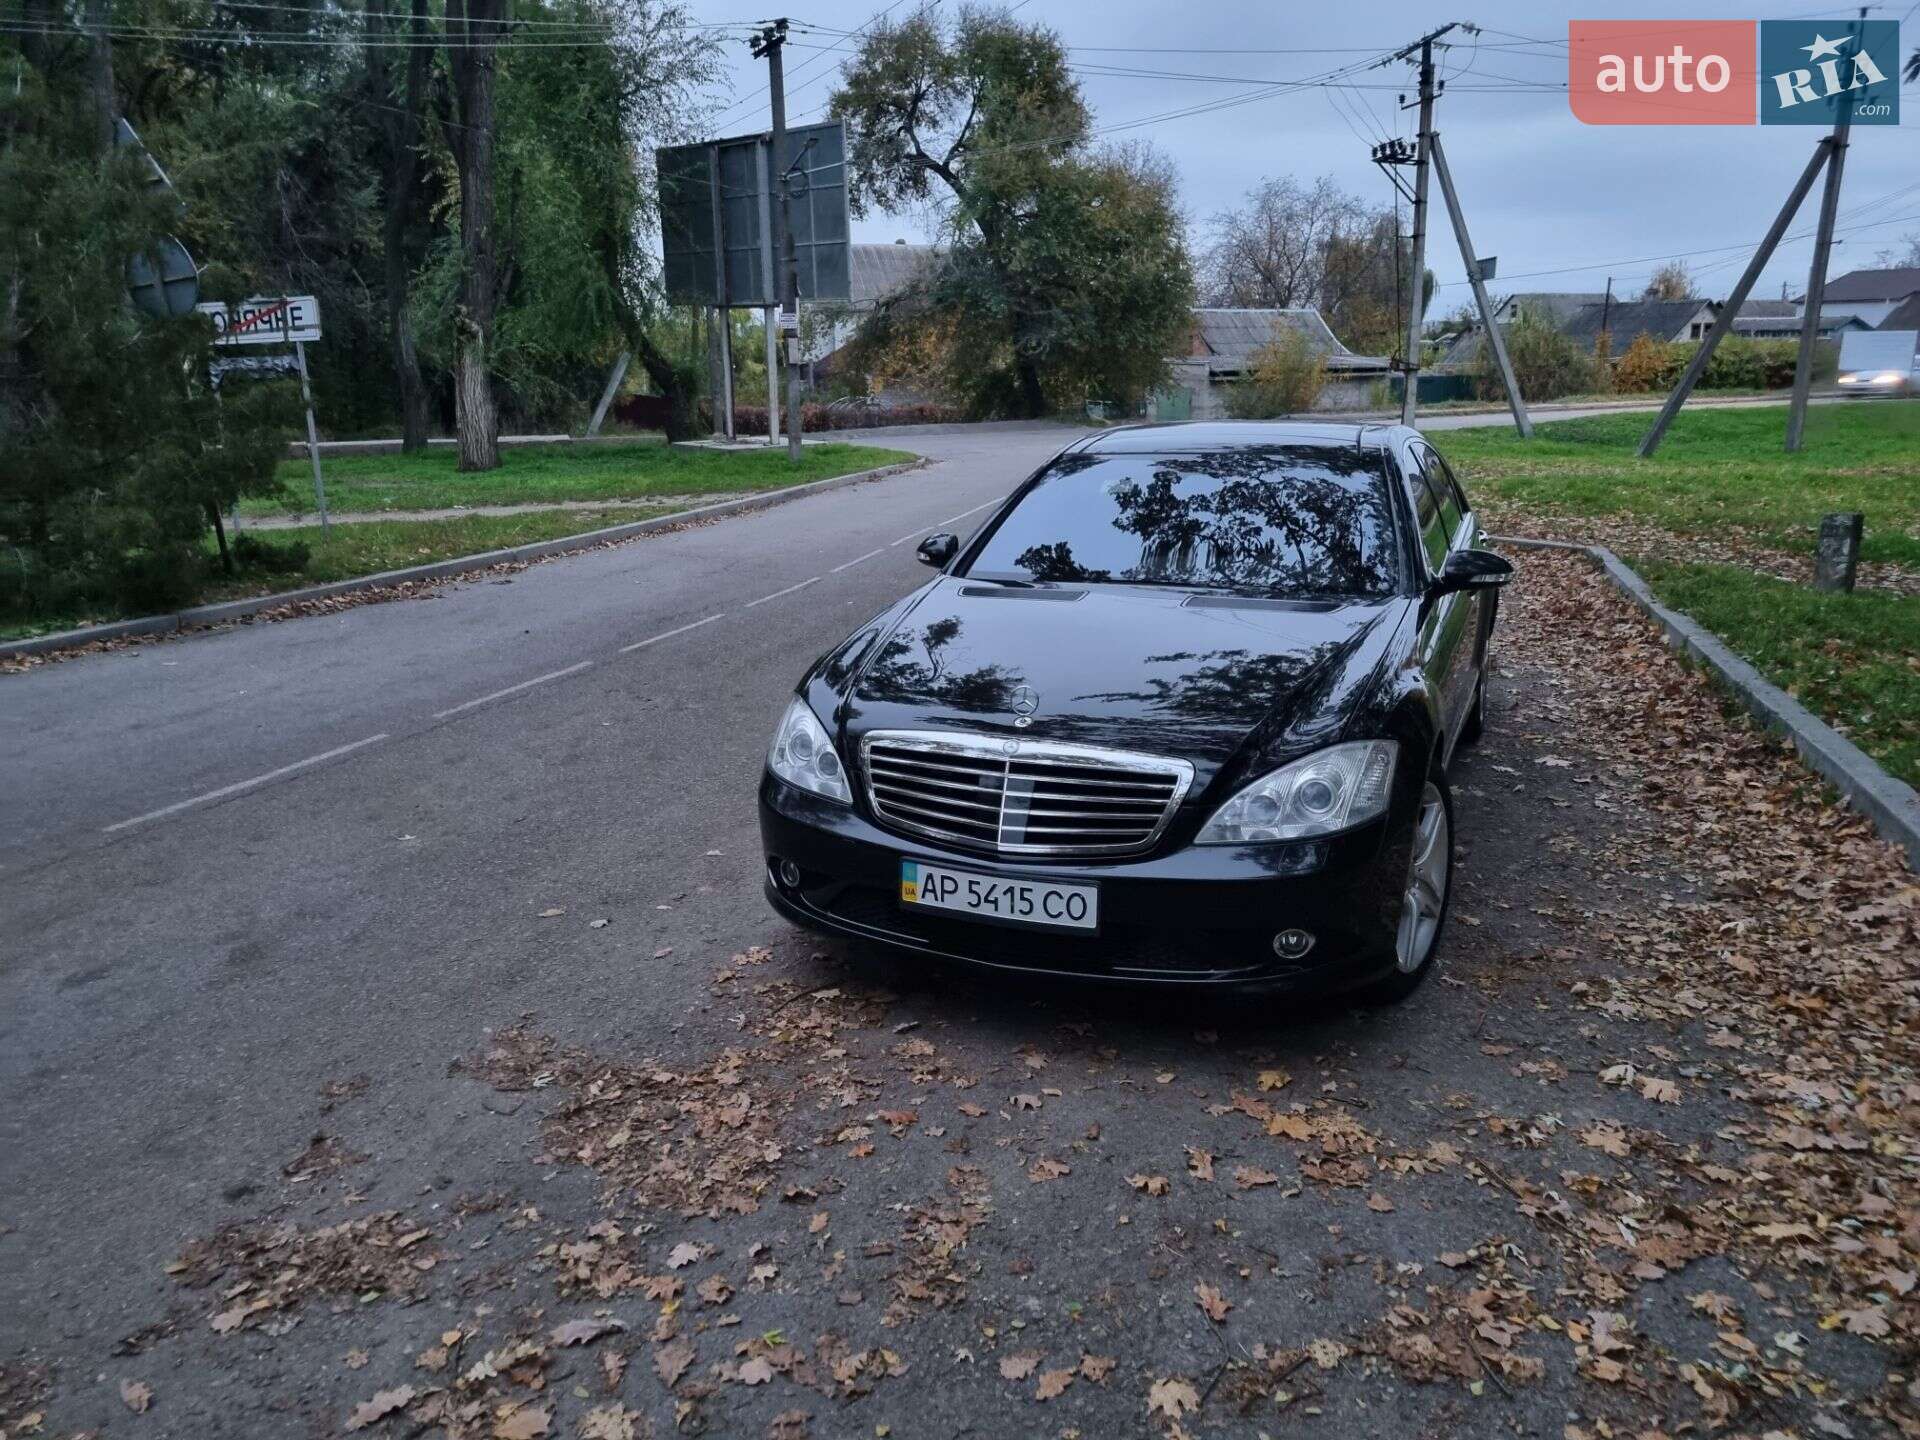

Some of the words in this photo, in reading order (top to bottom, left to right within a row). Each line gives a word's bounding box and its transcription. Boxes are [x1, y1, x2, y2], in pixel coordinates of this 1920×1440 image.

[905, 887, 916, 897] UA
[921, 872, 959, 903] AP
[967, 879, 1034, 916] 5415
[1042, 890, 1088, 921] CO
